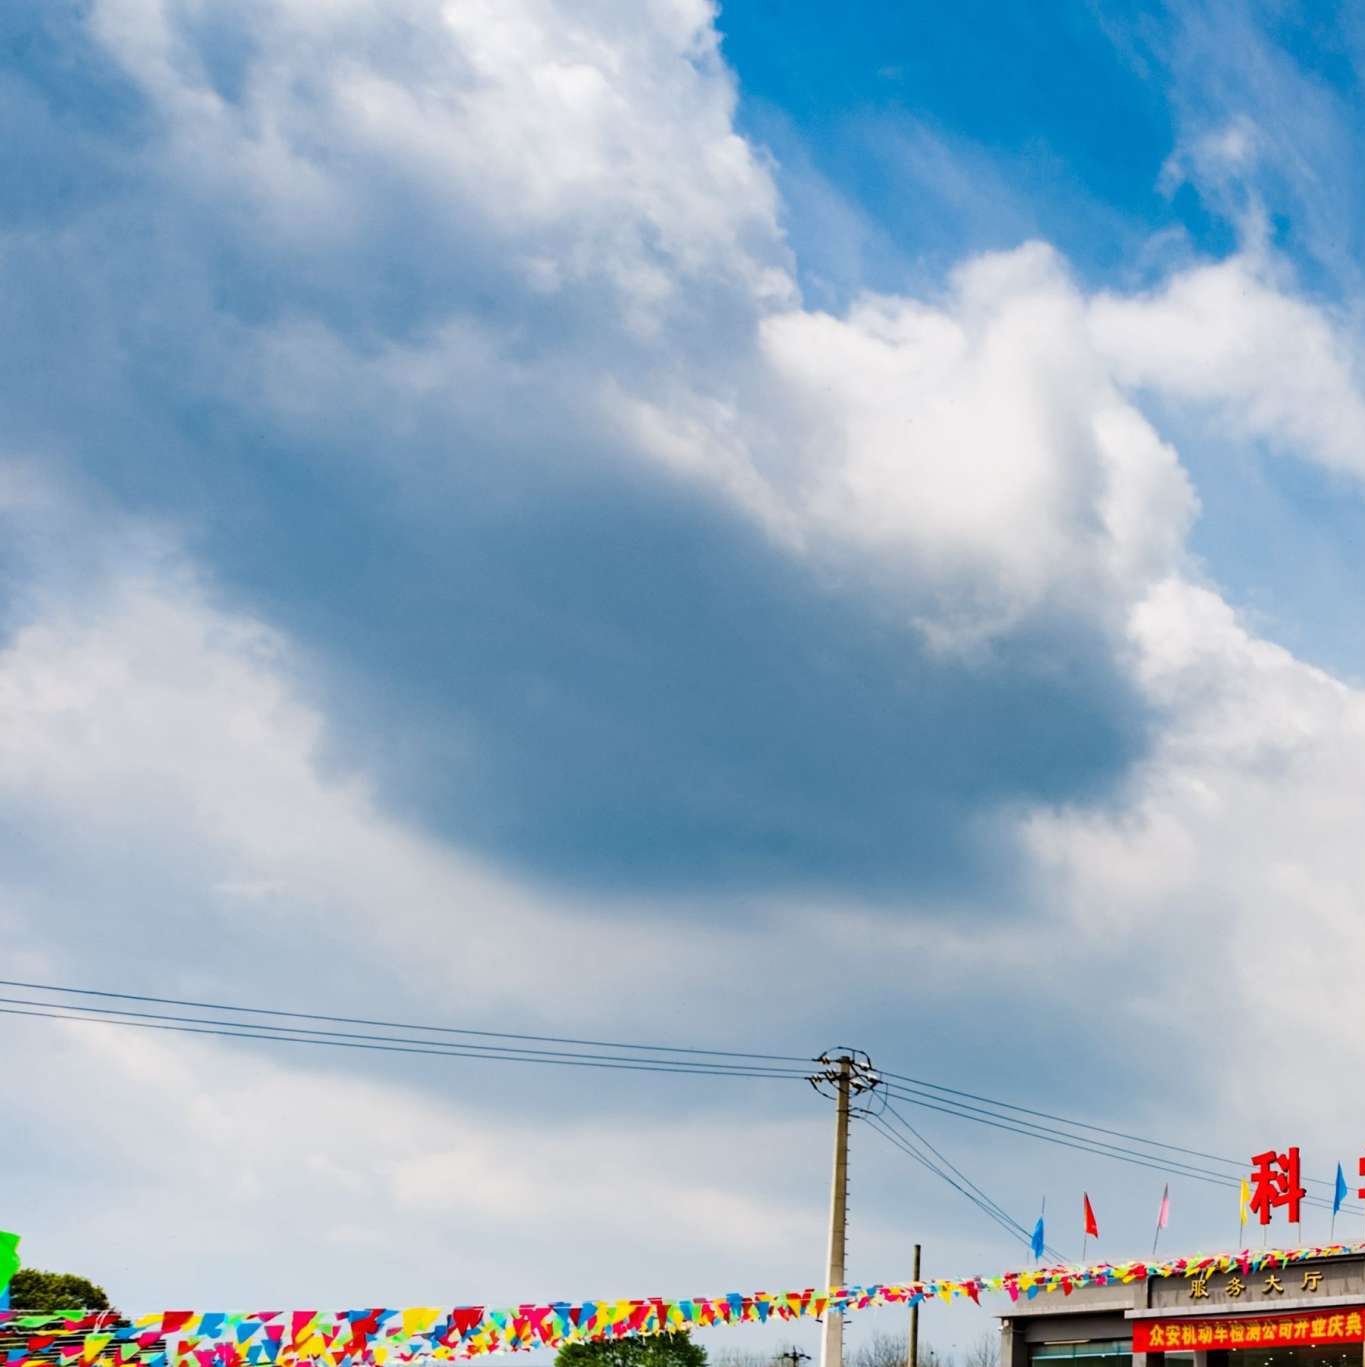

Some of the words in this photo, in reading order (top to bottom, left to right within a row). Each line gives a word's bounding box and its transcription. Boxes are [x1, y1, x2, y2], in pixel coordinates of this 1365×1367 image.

[1188, 1271, 1323, 1298] 服务大厅
[1149, 1311, 1362, 1346] 众安机动车检测公司开业庆典
